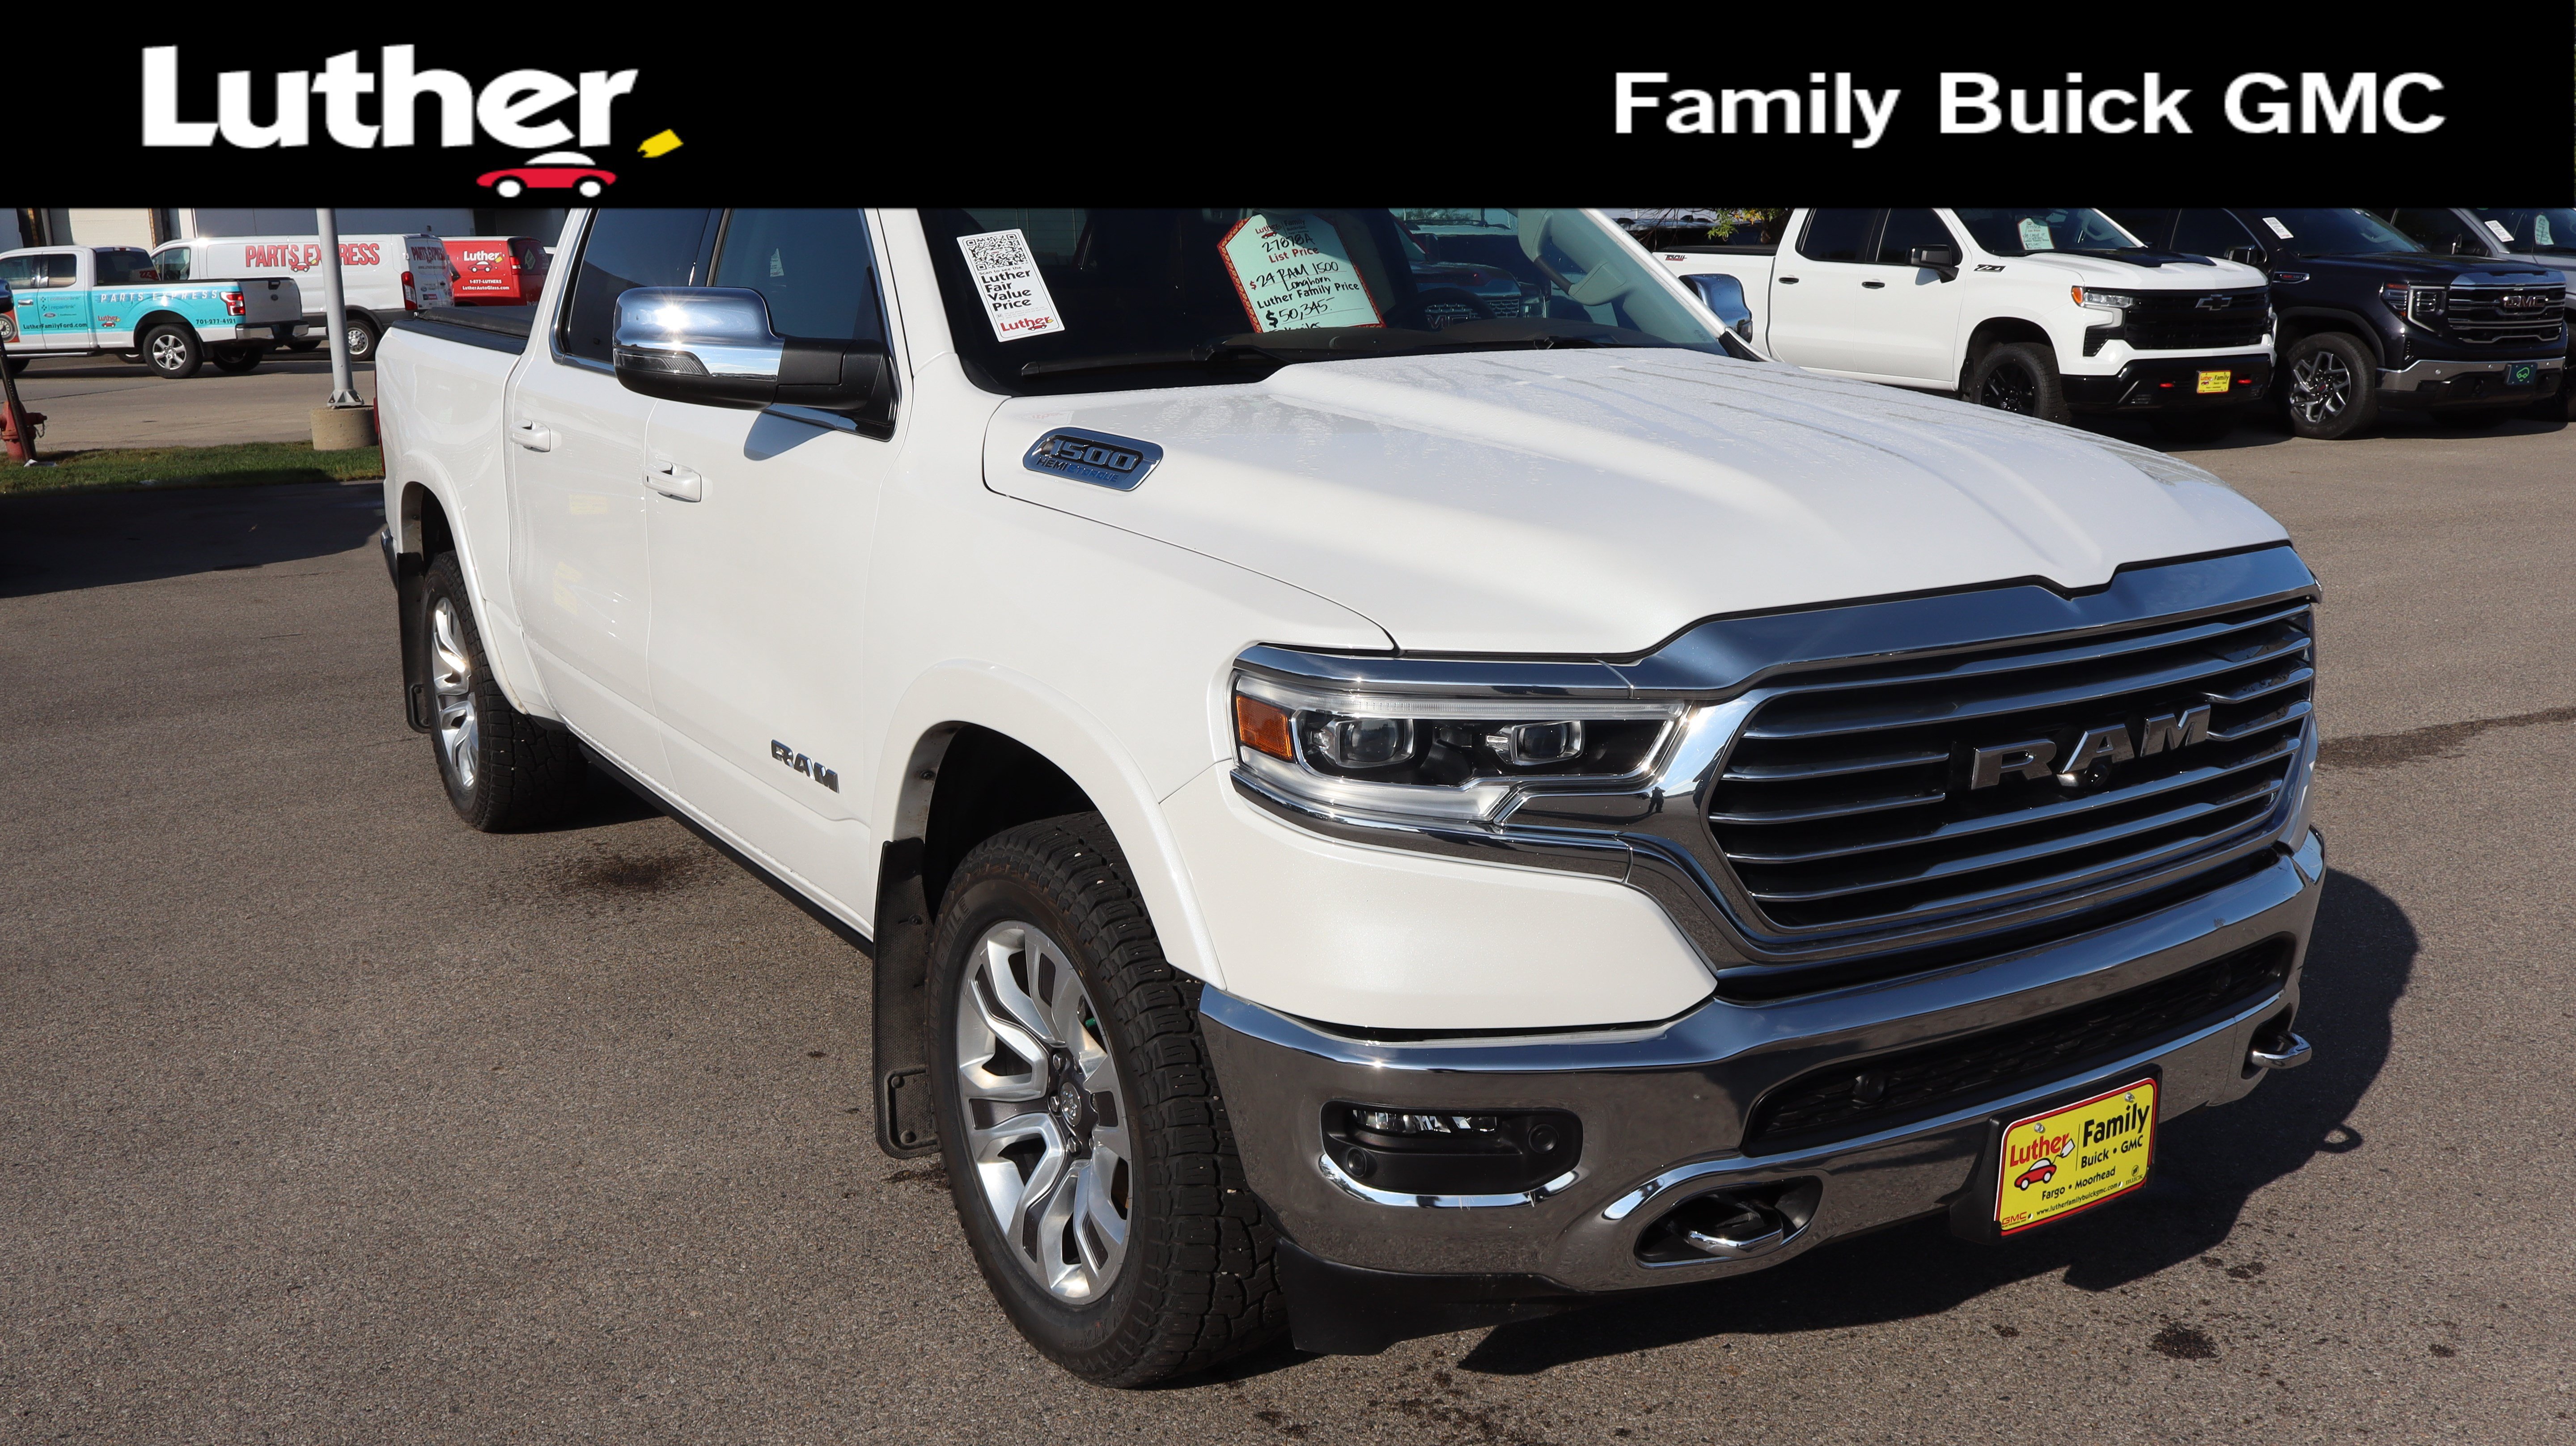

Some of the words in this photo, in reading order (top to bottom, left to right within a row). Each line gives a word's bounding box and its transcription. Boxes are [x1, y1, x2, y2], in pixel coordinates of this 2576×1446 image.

[1255, 224, 1279, 234] Luther
[246, 244, 299, 267] PARTS
[304, 243, 380, 267] EXRESS
[463, 250, 500, 261] Luther
[1268, 251, 1289, 263] List
[1292, 247, 1320, 257] Price
[1312, 262, 1339, 275] 1500
[981, 270, 1031, 284] Luther
[1283, 276, 1330, 291] Longhorn
[984, 281, 1012, 293] Fair
[101, 292, 144, 302] PARTS
[987, 289, 1032, 301] Value
[1257, 293, 1293, 309] Luther
[1296, 285, 1331, 298] Family
[1335, 283, 1360, 291] Price
[992, 299, 1032, 312] Price
[1000, 316, 1050, 331] Luther
[1049, 438, 1139, 471] 1500
[1971, 704, 2211, 790] RAM
[771, 739, 840, 794] RAM
[2010, 1132, 2070, 1167] Luther
[2082, 1103, 2150, 1148] Family
[2080, 1148, 2109, 1169] Buick
[2121, 1134, 2144, 1153] GMC
[2042, 1186, 2065, 1201] Fargo
[2074, 1166, 2116, 1190] Moorhead
[2036, 1183, 2118, 1216] www.lutherfamilybuickgmc.com
[2001, 1211, 2027, 1225] GMC
